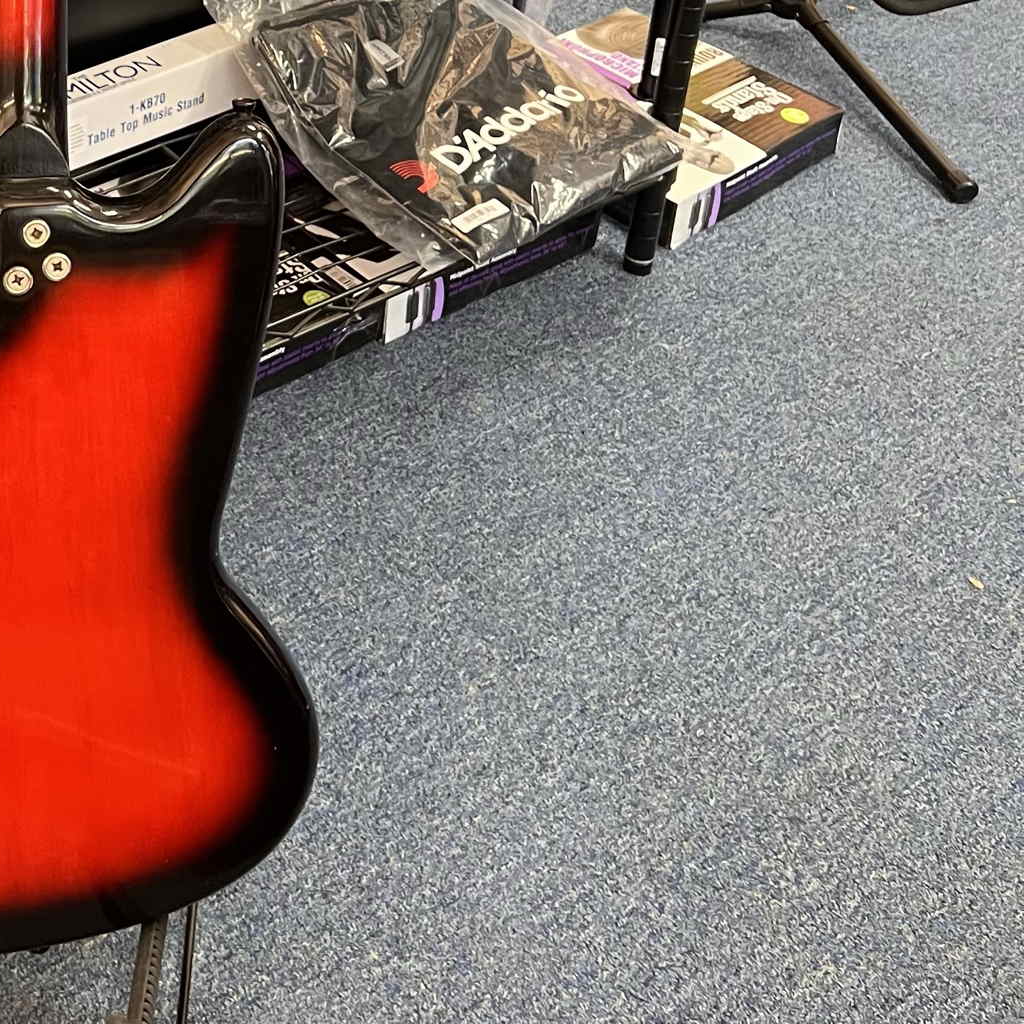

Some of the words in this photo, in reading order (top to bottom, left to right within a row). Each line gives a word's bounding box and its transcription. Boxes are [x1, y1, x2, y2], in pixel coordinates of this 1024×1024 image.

[88, 127, 115, 146] Table
[120, 117, 138, 133] Top
[143, 105, 174, 125] Music
[177, 91, 205, 113] Stand
[431, 84, 585, 175] D'Addario
